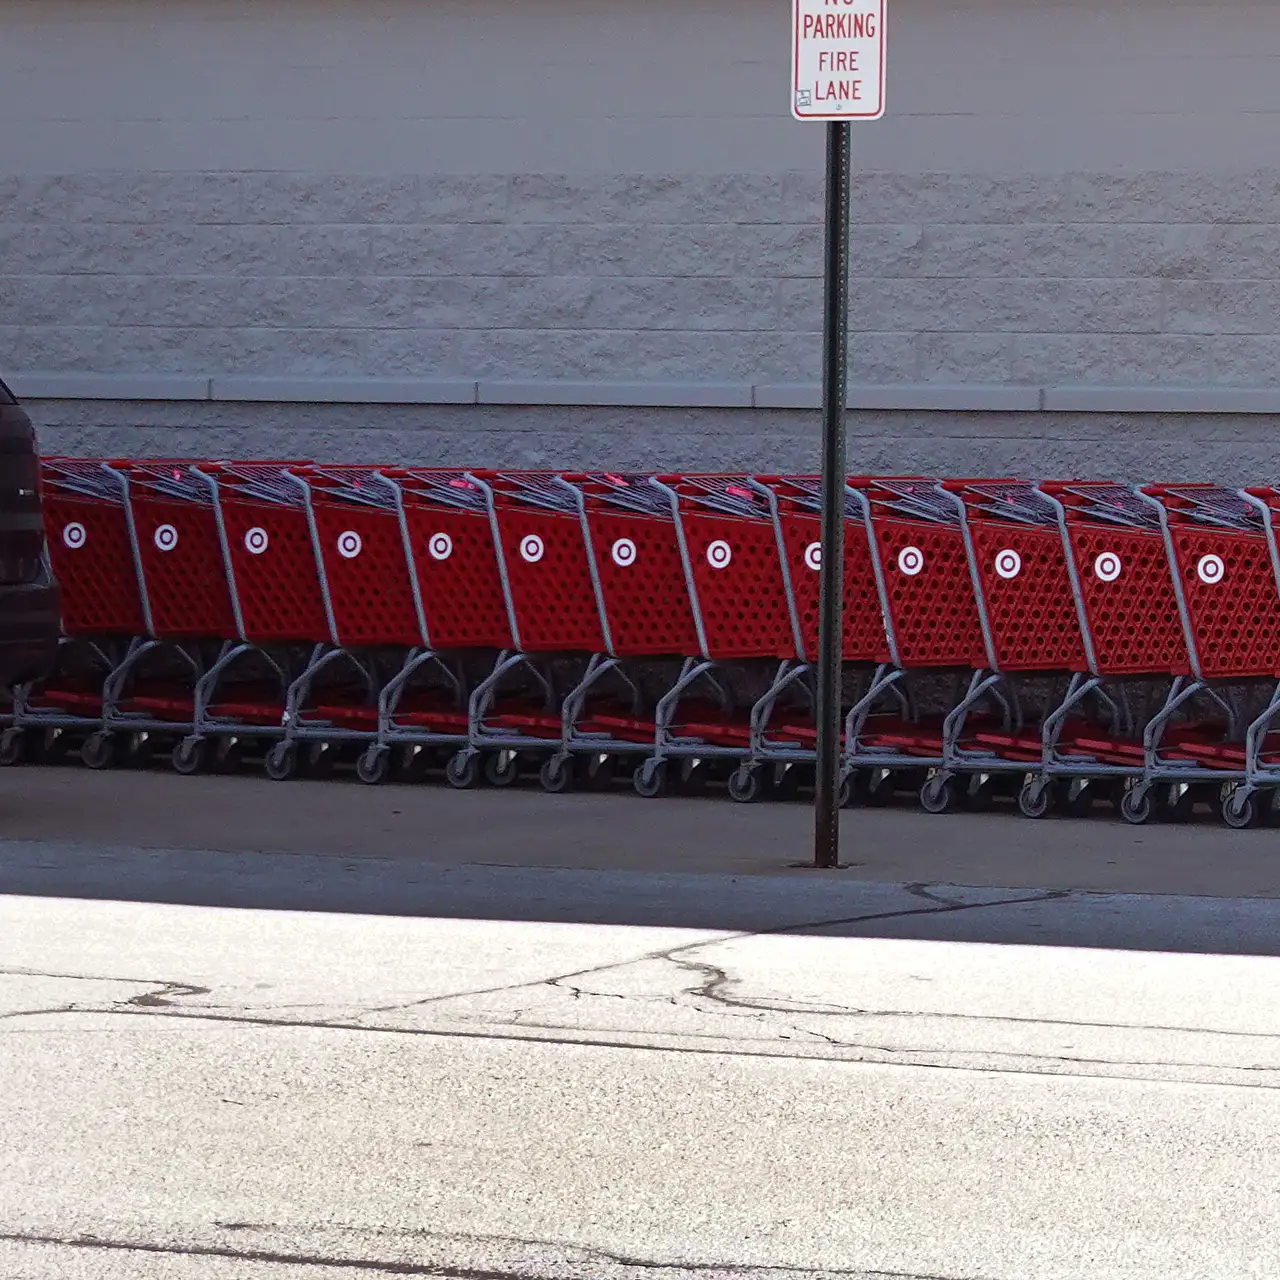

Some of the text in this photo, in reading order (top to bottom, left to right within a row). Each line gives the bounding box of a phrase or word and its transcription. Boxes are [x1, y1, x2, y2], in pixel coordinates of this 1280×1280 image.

[803, 13, 876, 39] PARKING
[818, 51, 860, 72] FIRE
[815, 80, 862, 101] LANE
